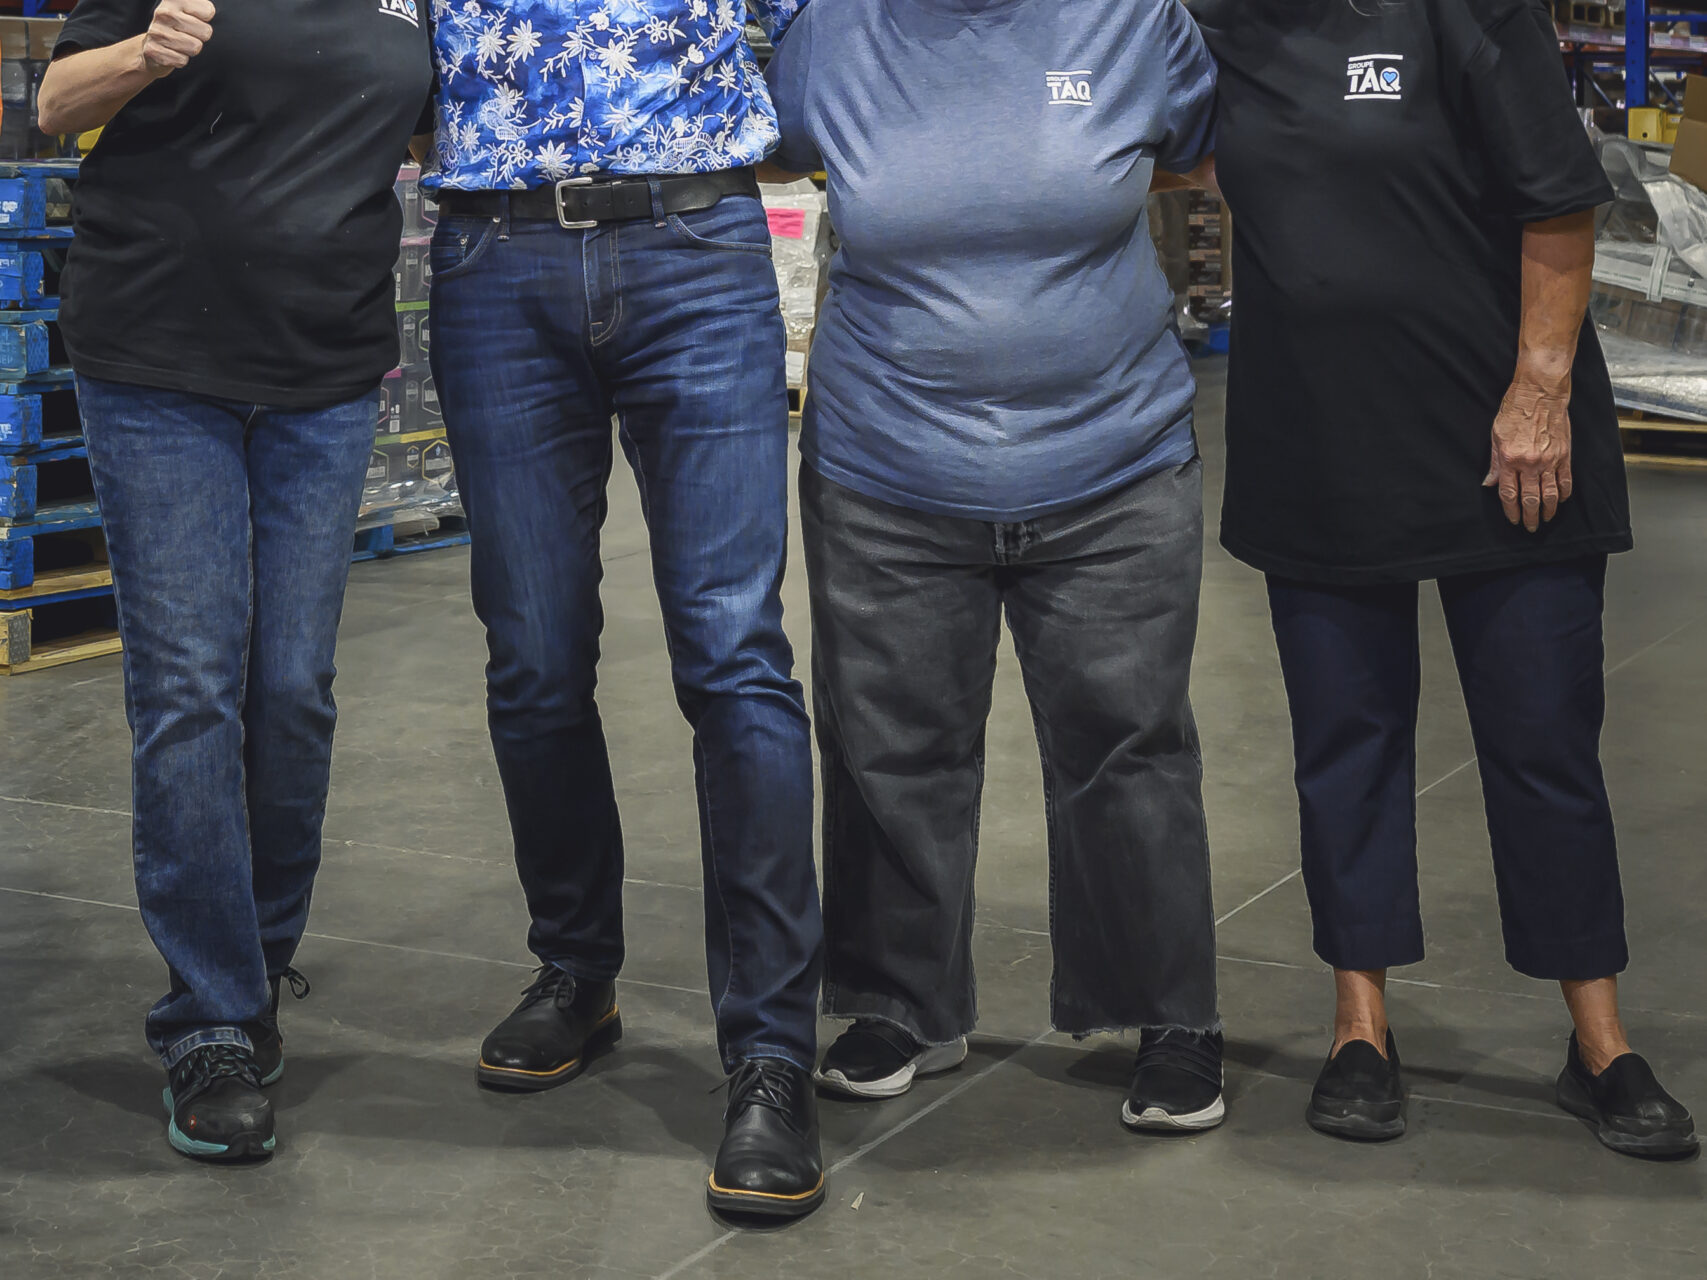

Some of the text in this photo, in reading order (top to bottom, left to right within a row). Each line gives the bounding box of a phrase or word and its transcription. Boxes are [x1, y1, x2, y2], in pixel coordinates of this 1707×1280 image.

[1348, 61, 1374, 70] GROUPE
[1347, 67, 1401, 92] TAQ
[1047, 80, 1092, 101] TAQ
